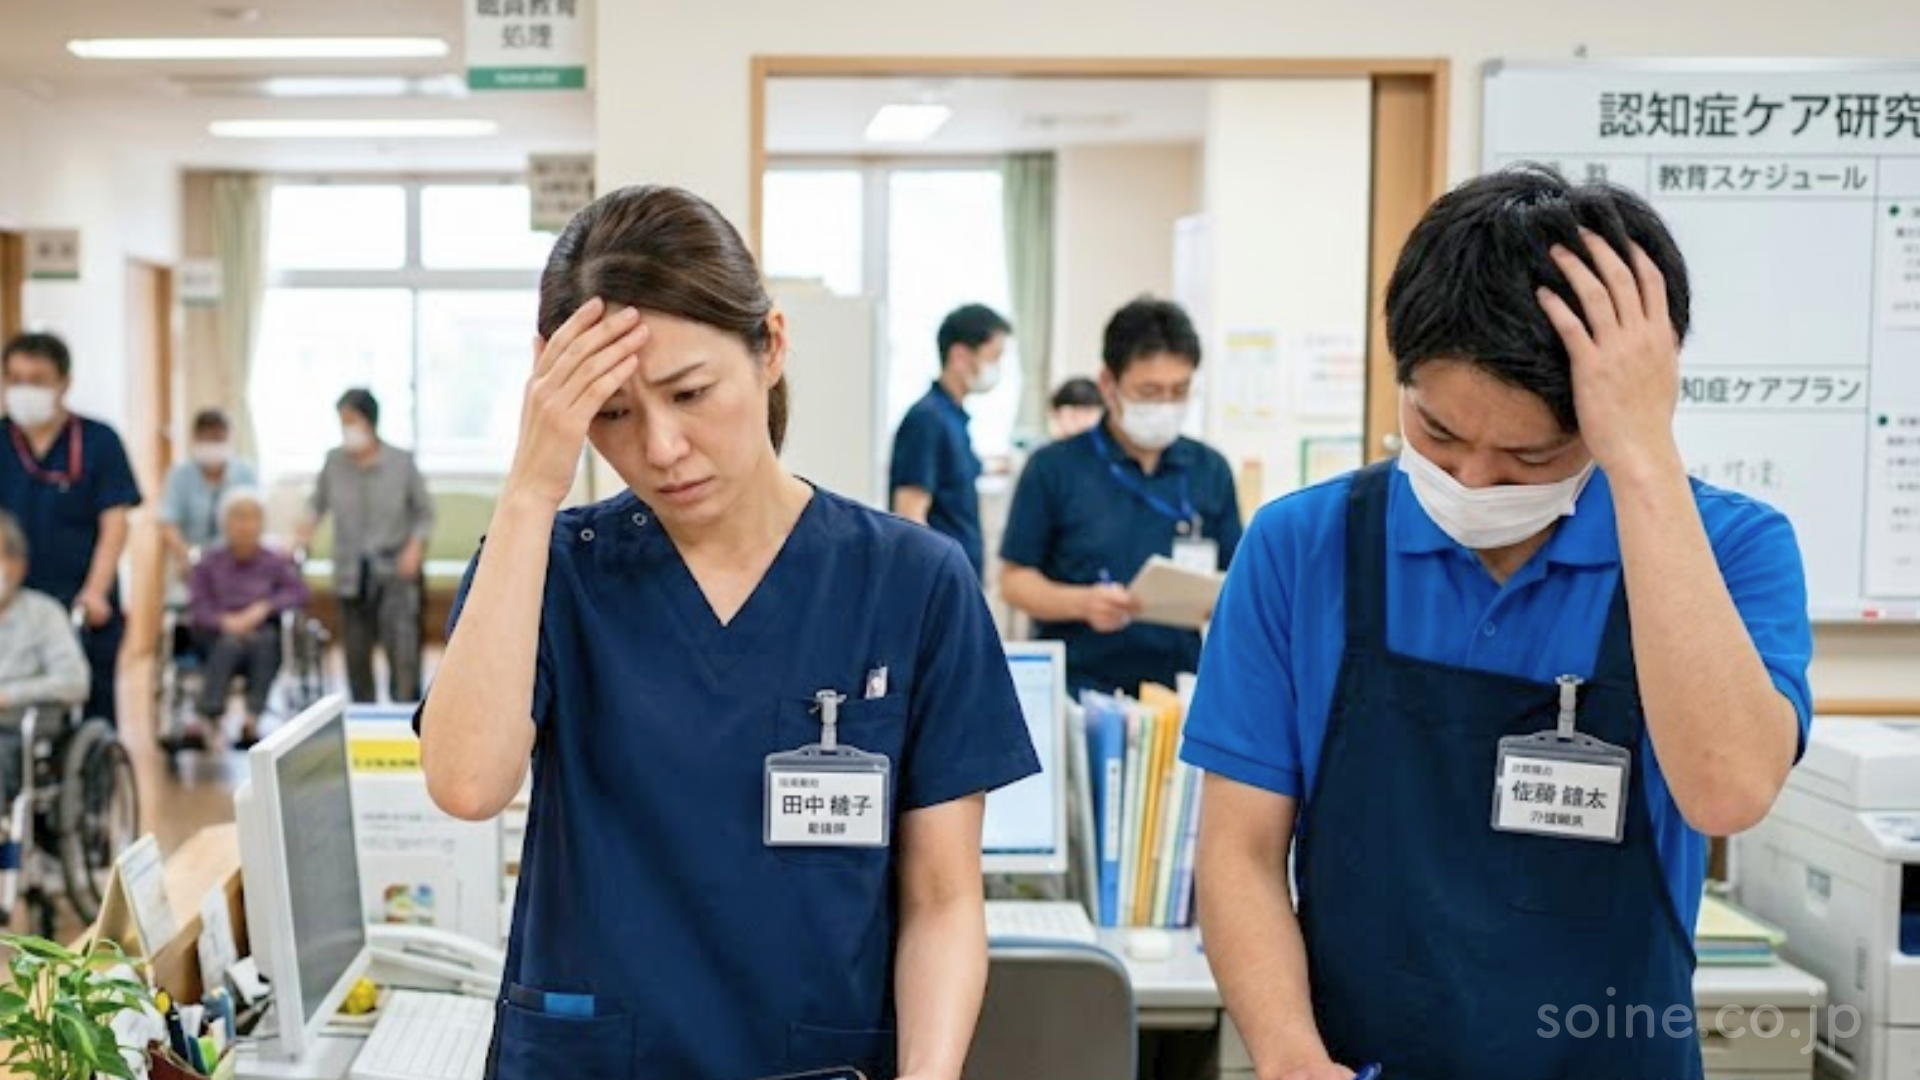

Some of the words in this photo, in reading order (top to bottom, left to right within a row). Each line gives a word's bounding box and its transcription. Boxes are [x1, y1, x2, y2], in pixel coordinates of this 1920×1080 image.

[1599, 91, 1920, 139] 認知症ケア研究
[1658, 163, 1868, 192] 教育スケジュール
[783, 795, 824, 816] 田中
